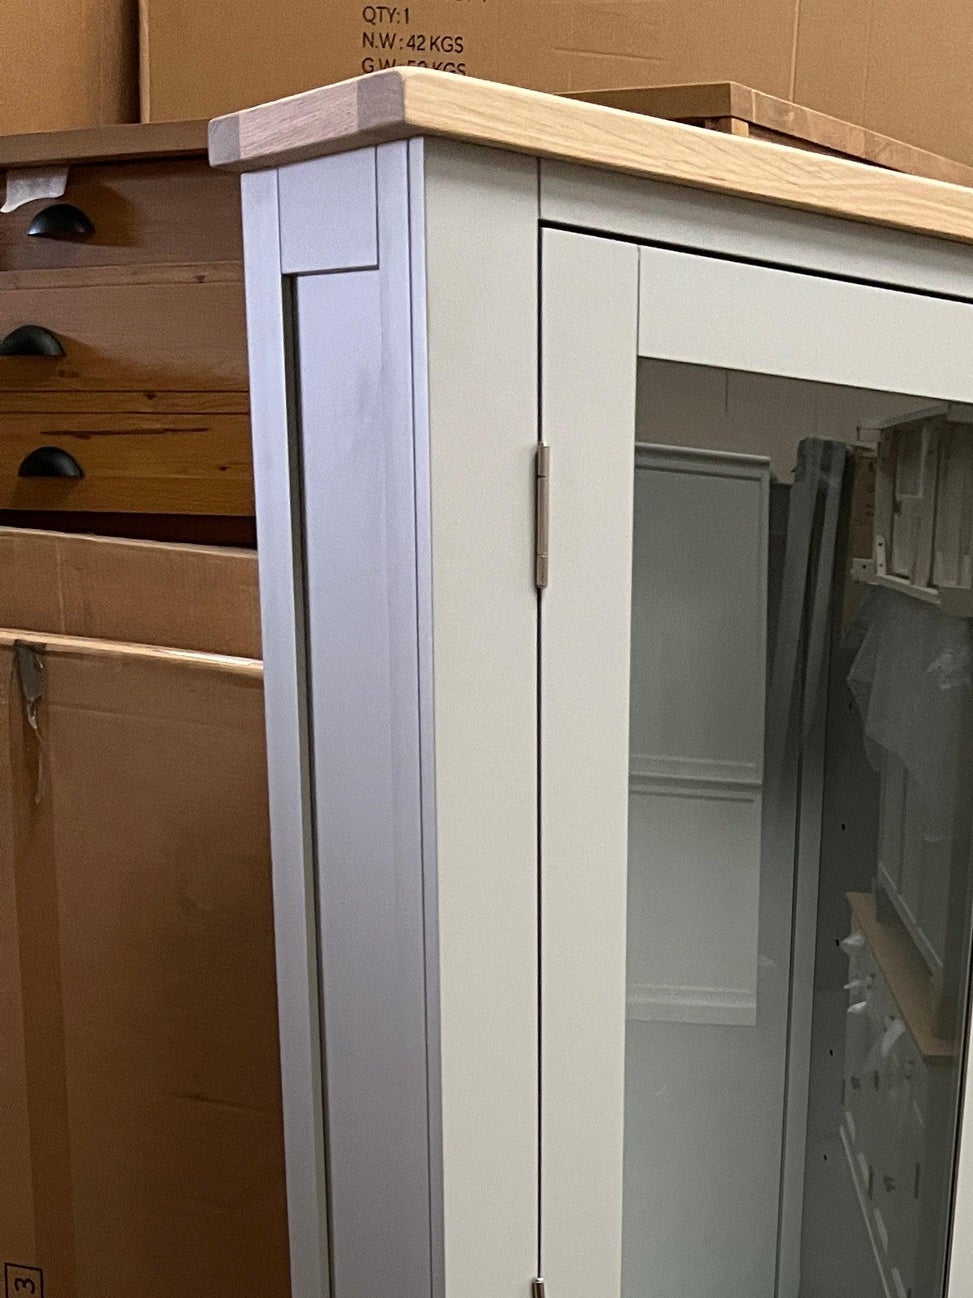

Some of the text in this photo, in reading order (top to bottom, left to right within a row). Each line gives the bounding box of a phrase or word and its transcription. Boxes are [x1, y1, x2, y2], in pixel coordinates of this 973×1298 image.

[406, 34, 426, 51] 42
[429, 35, 464, 53] KGS
[14, 1277, 36, 1294] 3
